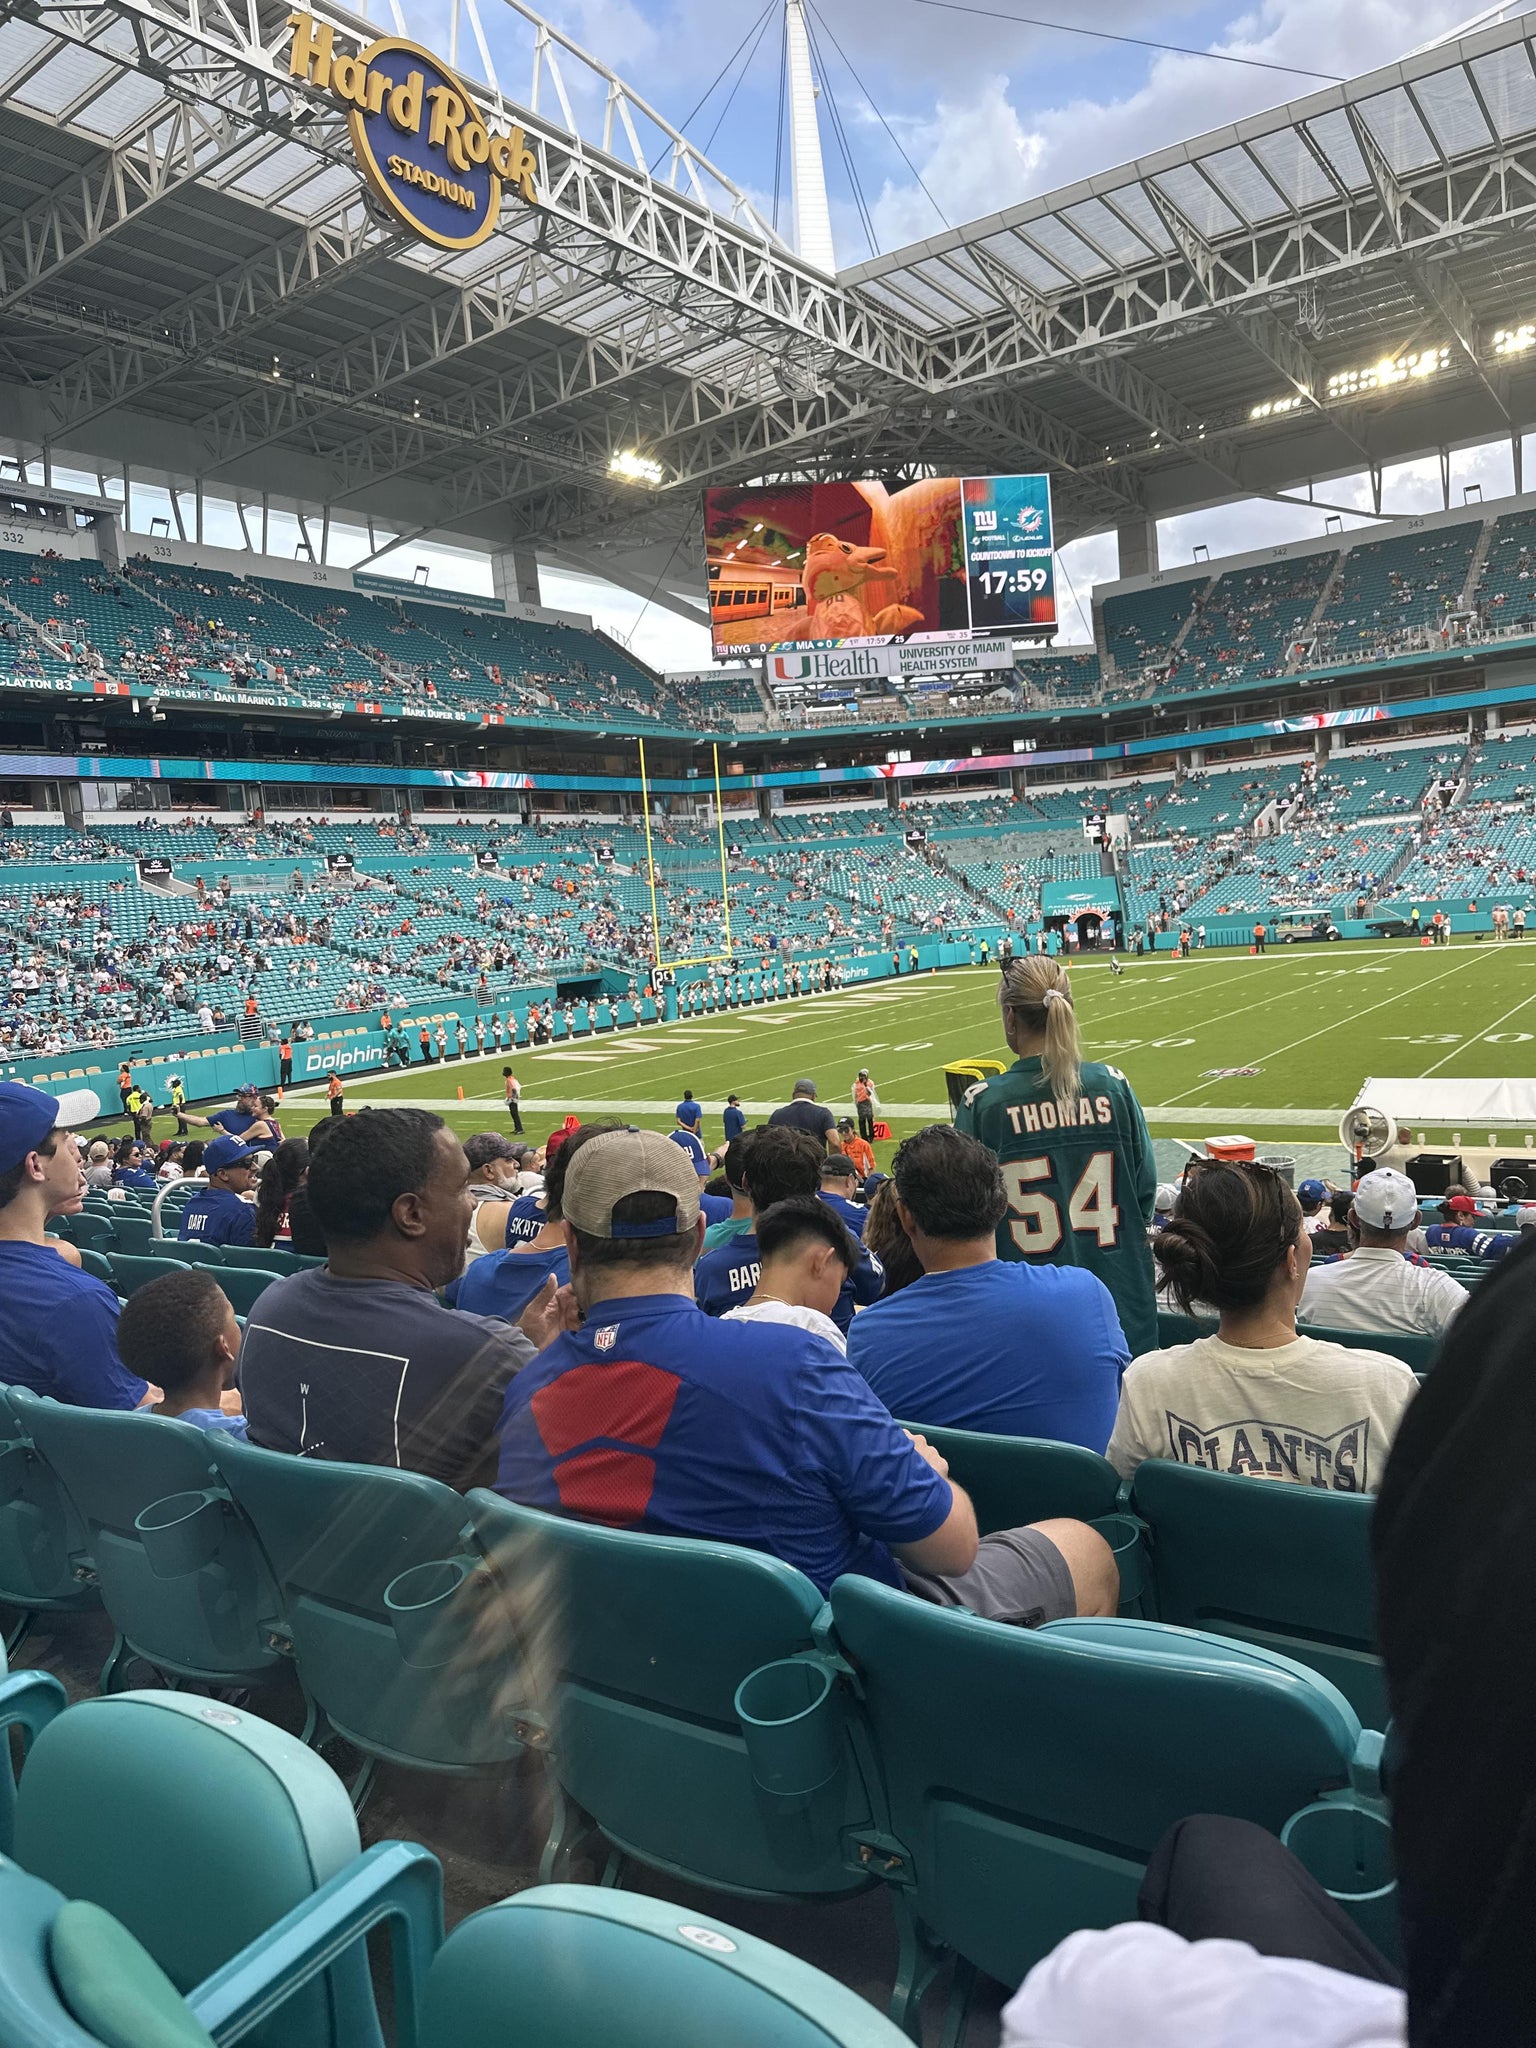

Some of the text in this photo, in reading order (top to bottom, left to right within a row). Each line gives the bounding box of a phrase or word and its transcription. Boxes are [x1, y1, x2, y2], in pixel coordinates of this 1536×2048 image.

[286, 12, 538, 203] Hard Rock
[387, 154, 477, 211] STADIUM
[1407, 518, 1425, 529] 343
[3, 531, 24, 544] 332
[154, 545, 172, 557] 333
[971, 547, 1052, 561] COUNTDOWN TO KICKOFF
[1272, 547, 1288, 557] 342
[312, 571, 328, 582] 334
[979, 568, 1047, 594] 17:59
[1150, 574, 1164, 584] 341
[867, 637, 886, 645] 17:59
[894, 635, 905, 644] 25
[959, 631, 968, 639] 35
[730, 644, 751, 654] NYG
[759, 644, 767, 653] 0
[796, 640, 833, 650] MIA 0
[899, 642, 1006, 660] UNIVERSITY OF MIAMI
[900, 657, 978, 672] HEALTH SYSTEM
[706, 671, 721, 679] 337
[55, 679, 73, 691] 83
[213, 691, 235, 703] DAN
[237, 693, 275, 706] MARINO
[276, 696, 288, 707] 13
[402, 706, 466, 721] MARK DUPER 85
[530, 985, 957, 1063] MIAMI
[306, 1045, 392, 1072] Dolphins
[1006, 1095, 1112, 1135] THOMAS
[872, 1124, 885, 1138] 20
[999, 1151, 1120, 1255] 54
[187, 1214, 208, 1231] DART
[728, 1260, 763, 1292] BAR
[597, 1332, 613, 1347] NFL
[300, 1382, 310, 1395] W
[1178, 1425, 1359, 1493] GIANTS
